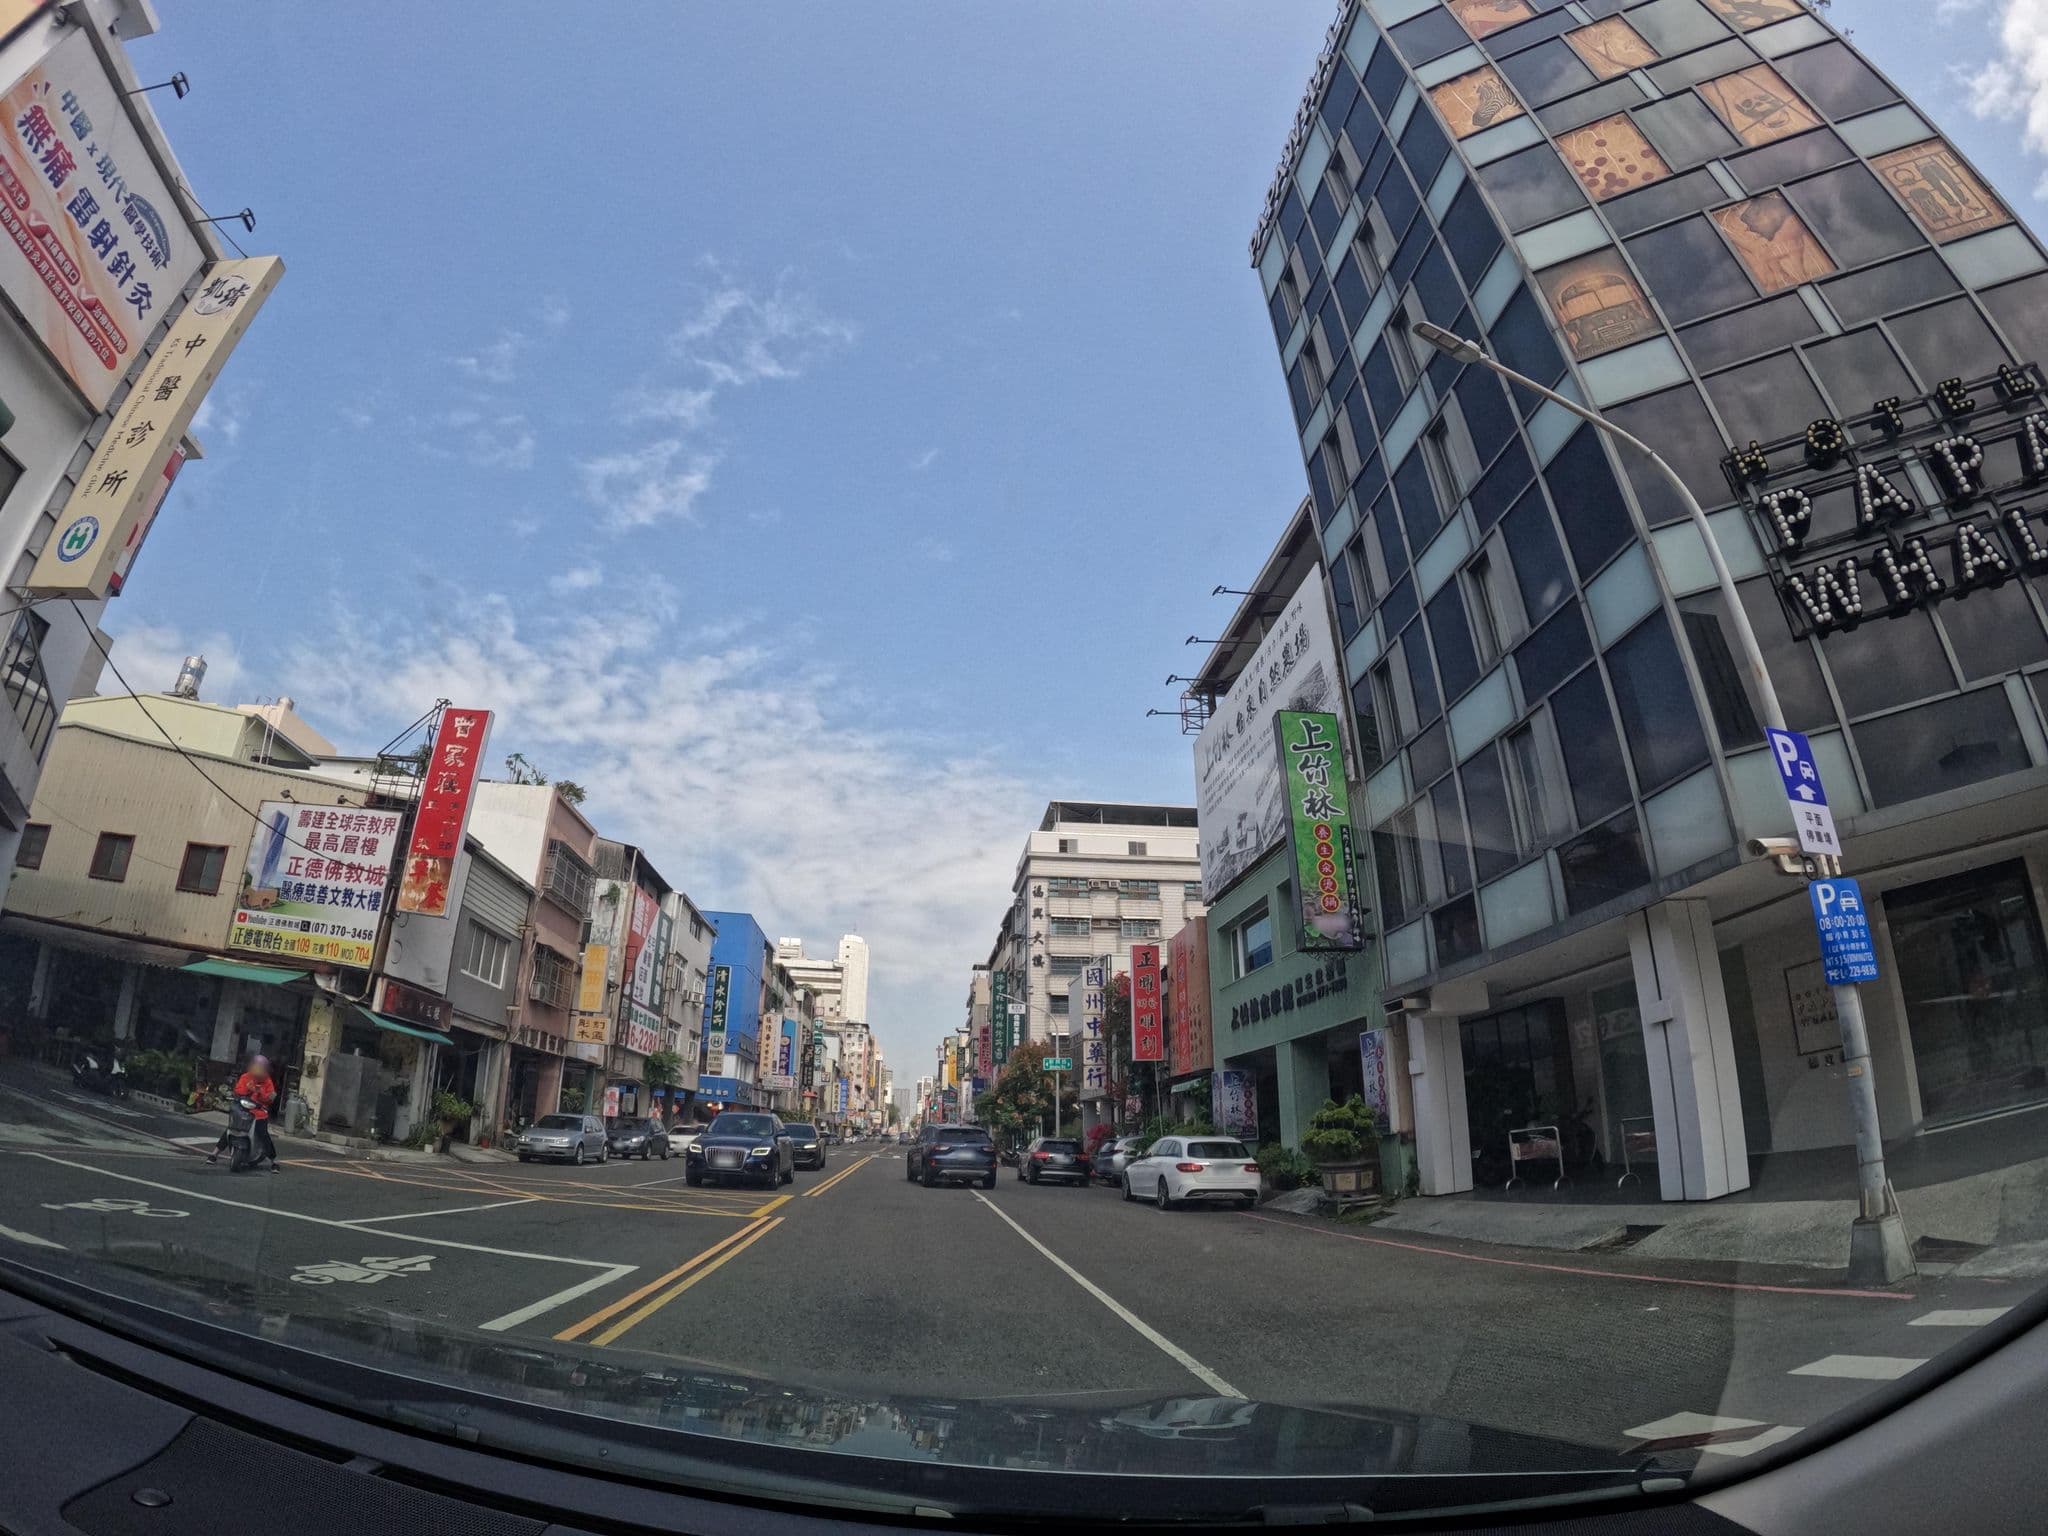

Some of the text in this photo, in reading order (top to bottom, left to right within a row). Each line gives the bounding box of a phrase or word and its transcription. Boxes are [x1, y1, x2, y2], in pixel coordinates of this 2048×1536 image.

[61, 89, 93, 141] 中醫
[96, 153, 128, 203] 現代
[122, 201, 166, 271] 醫學技術
[17, 104, 77, 189] 無痛
[66, 187, 153, 320] 雷射針灸
[99, 333, 207, 498] 中醫診所
[1731, 364, 2034, 480] HOTEL
[97, 429, 124, 473] Medicine
[1291, 718, 1344, 820] 上竹林
[1772, 733, 1798, 777] P
[297, 810, 397, 836] 籌建全球宗教界
[1807, 829, 1832, 845] 停車場
[304, 832, 379, 857] 最高層樓
[285, 856, 385, 886] 正德佛教城
[279, 881, 382, 912] 醫療慈善文教大樓
[1817, 884, 1835, 915] P
[329, 925, 373, 941] 370-3456
[1820, 915, 1865, 930] 08:00-20:00
[233, 928, 283, 949] 正德電視台
[354, 947, 370, 962] 704
[1086, 968, 1105, 1088] 國州中藥行
